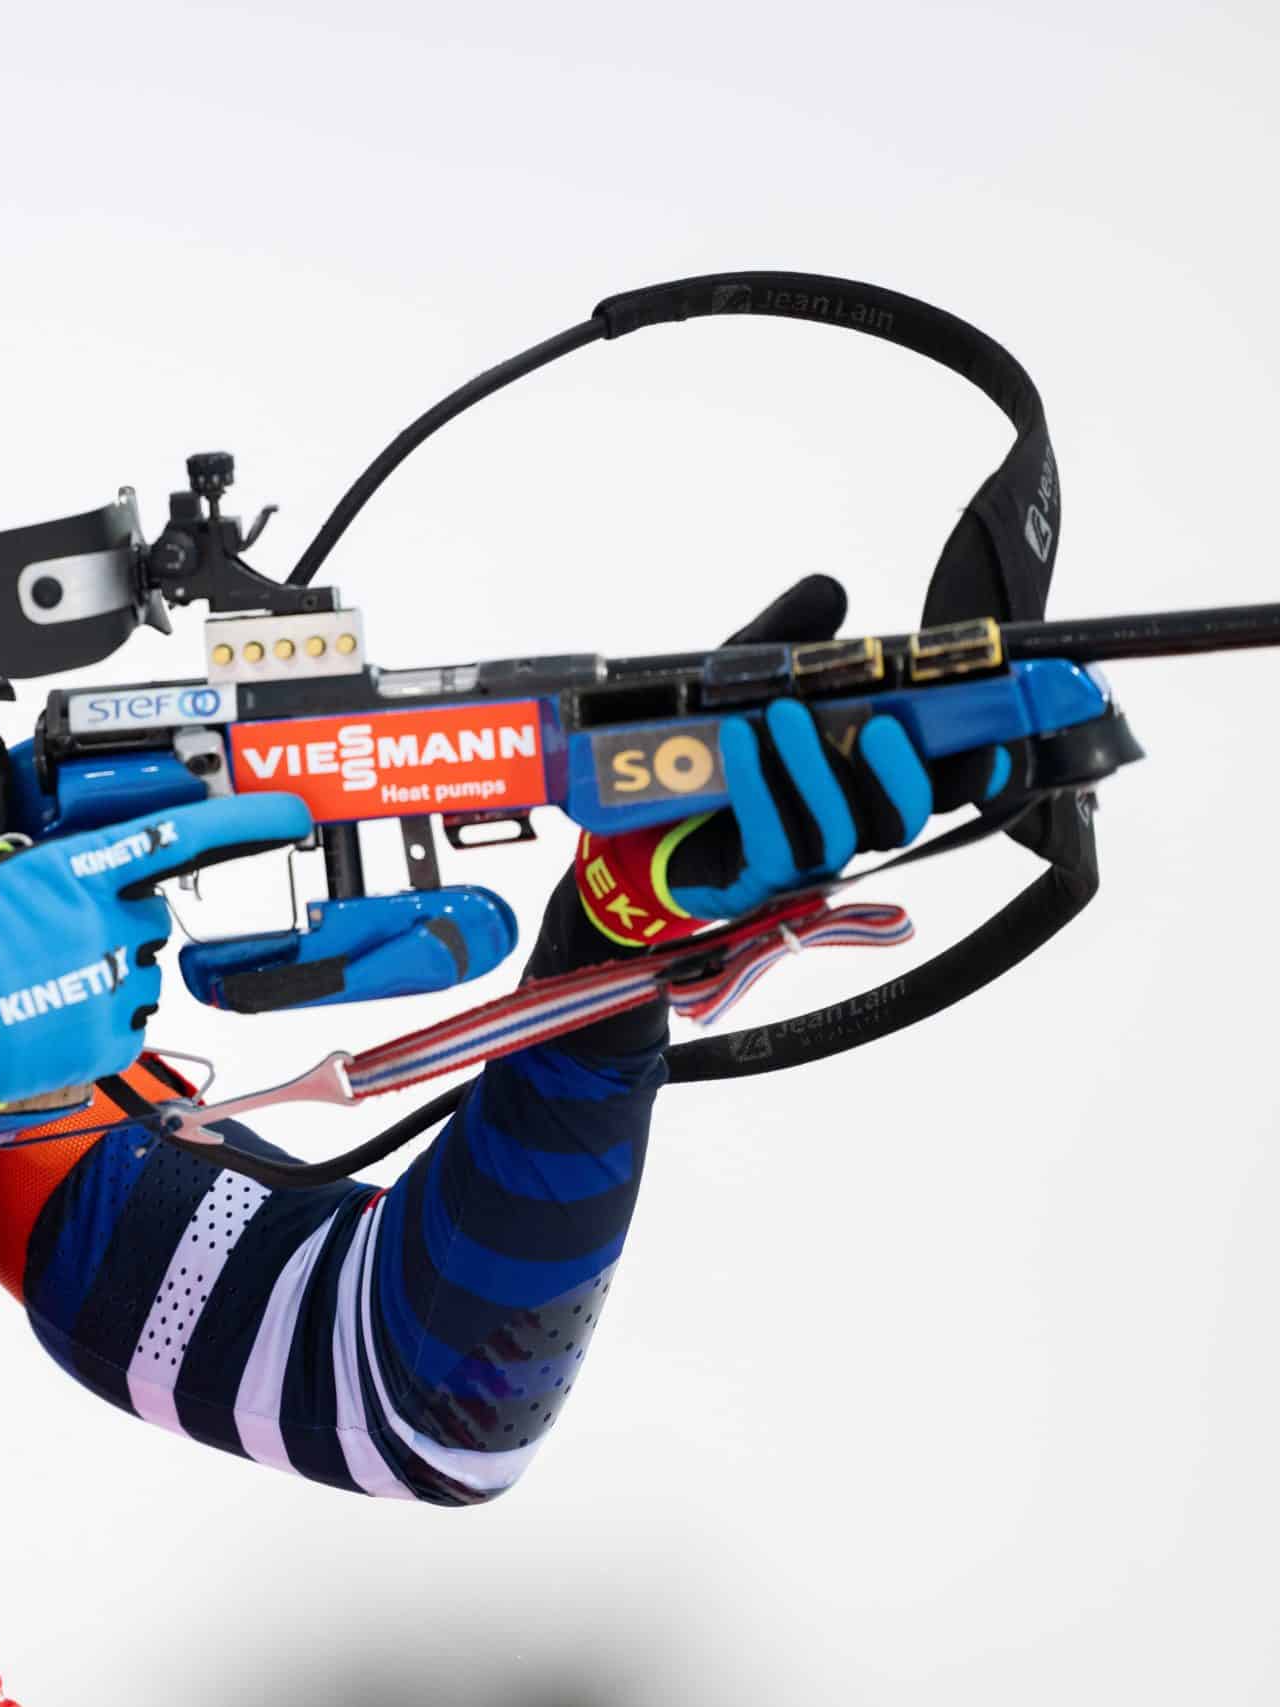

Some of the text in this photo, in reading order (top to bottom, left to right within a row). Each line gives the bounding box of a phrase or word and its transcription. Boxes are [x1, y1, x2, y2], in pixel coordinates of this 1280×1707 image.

[241, 724, 536, 792] VIESSMANN
[380, 778, 507, 804] Heat pumps
